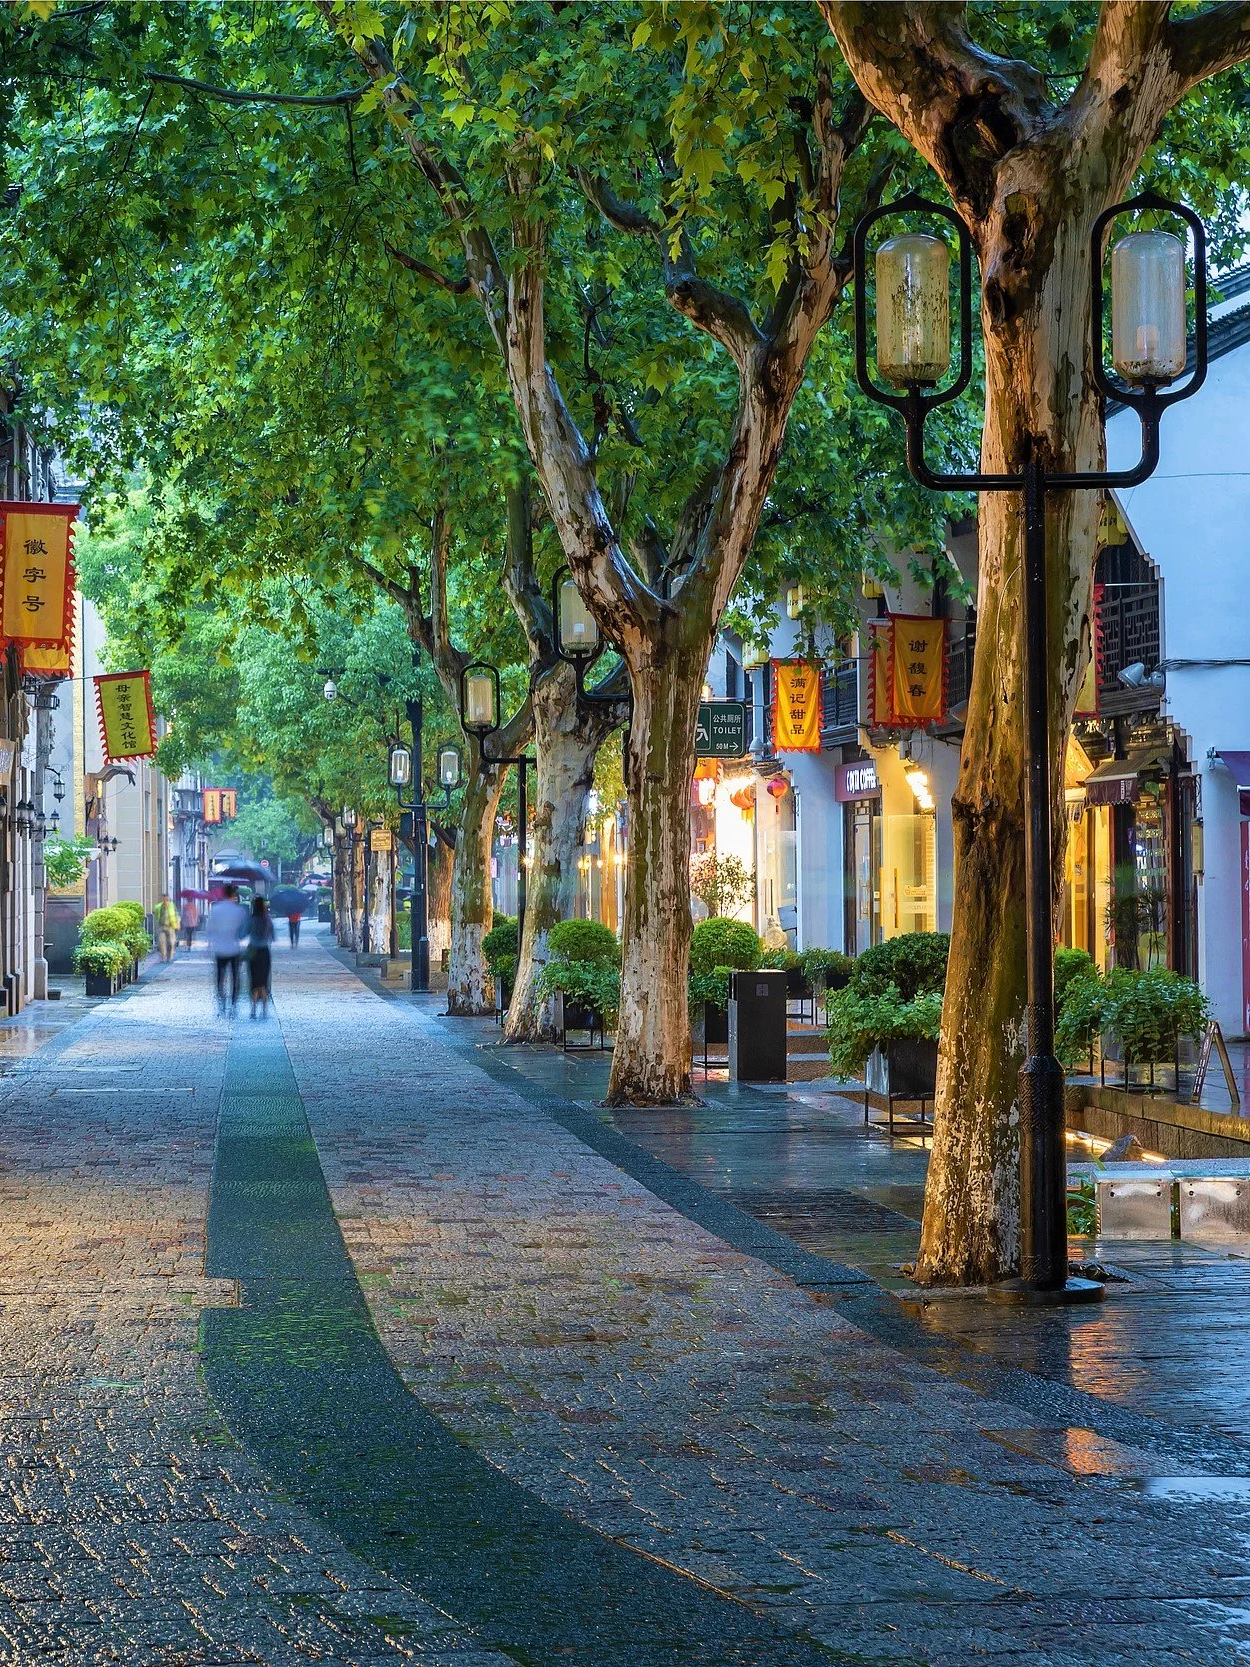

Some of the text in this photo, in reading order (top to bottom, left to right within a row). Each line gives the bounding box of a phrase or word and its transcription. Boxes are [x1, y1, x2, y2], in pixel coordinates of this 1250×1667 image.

[22, 539, 49, 612] 徽字号
[907, 639, 928, 697] 谢馥春
[712, 714, 742, 723] 公共厕所
[713, 726, 742, 734] TOILET
[789, 677, 807, 735] 满记甜品
